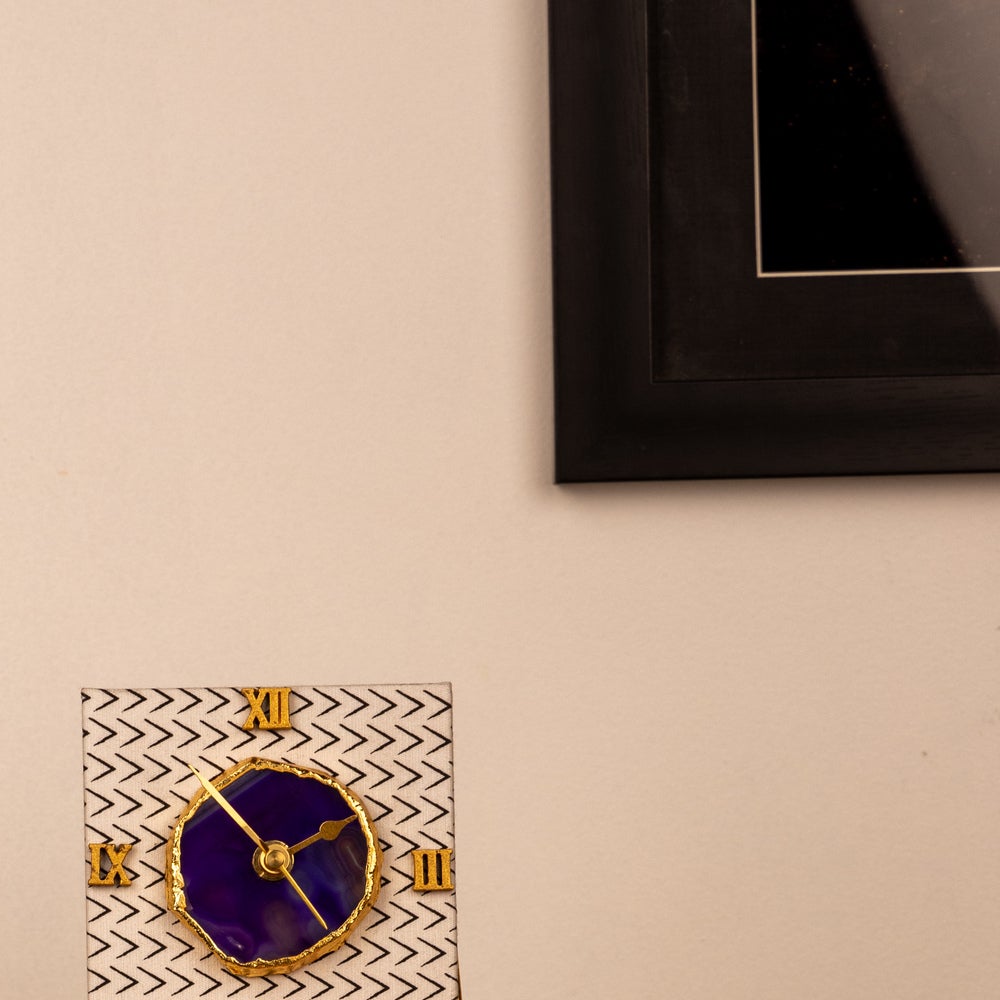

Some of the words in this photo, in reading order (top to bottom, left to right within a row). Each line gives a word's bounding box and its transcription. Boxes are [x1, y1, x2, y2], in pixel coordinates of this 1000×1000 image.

[242, 687, 293, 731] XII
[88, 843, 133, 887] IX
[412, 849, 455, 892] III
